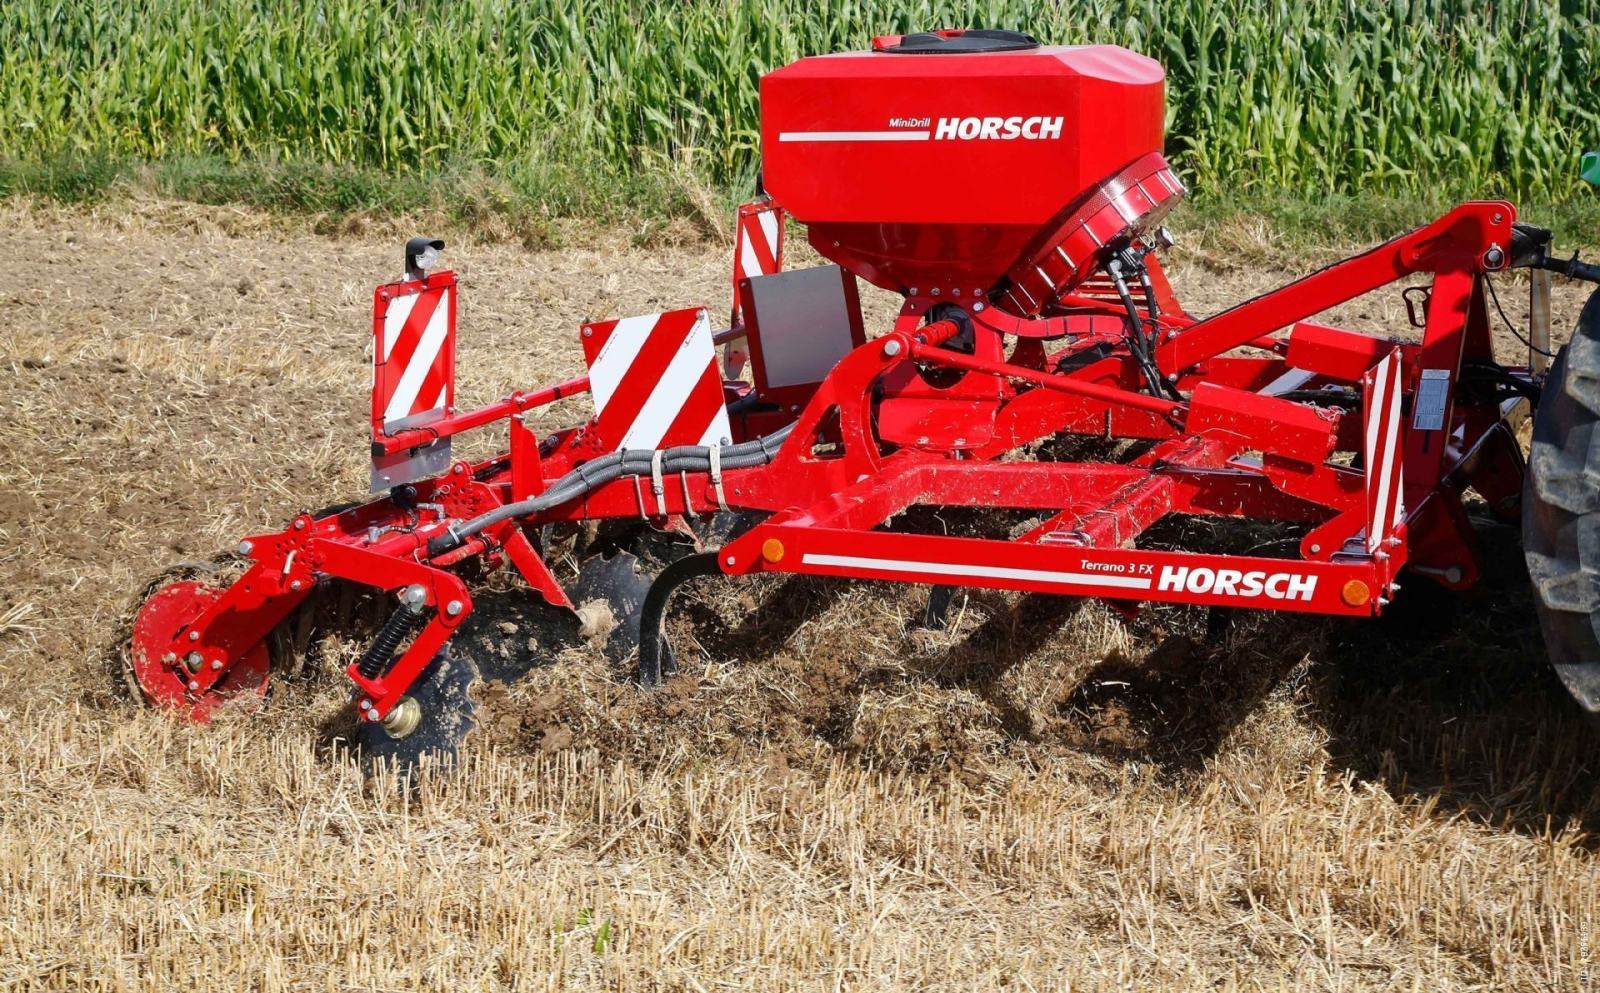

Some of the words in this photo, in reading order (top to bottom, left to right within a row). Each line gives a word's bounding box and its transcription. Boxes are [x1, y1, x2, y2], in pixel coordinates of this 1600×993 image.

[889, 117, 930, 128] MiniDrill
[934, 116, 1064, 140] HORSCH
[1080, 559, 1125, 573] Terrano
[1128, 563, 1136, 574] 3
[1139, 564, 1154, 575] FX
[1157, 565, 1318, 601] HORSCH
